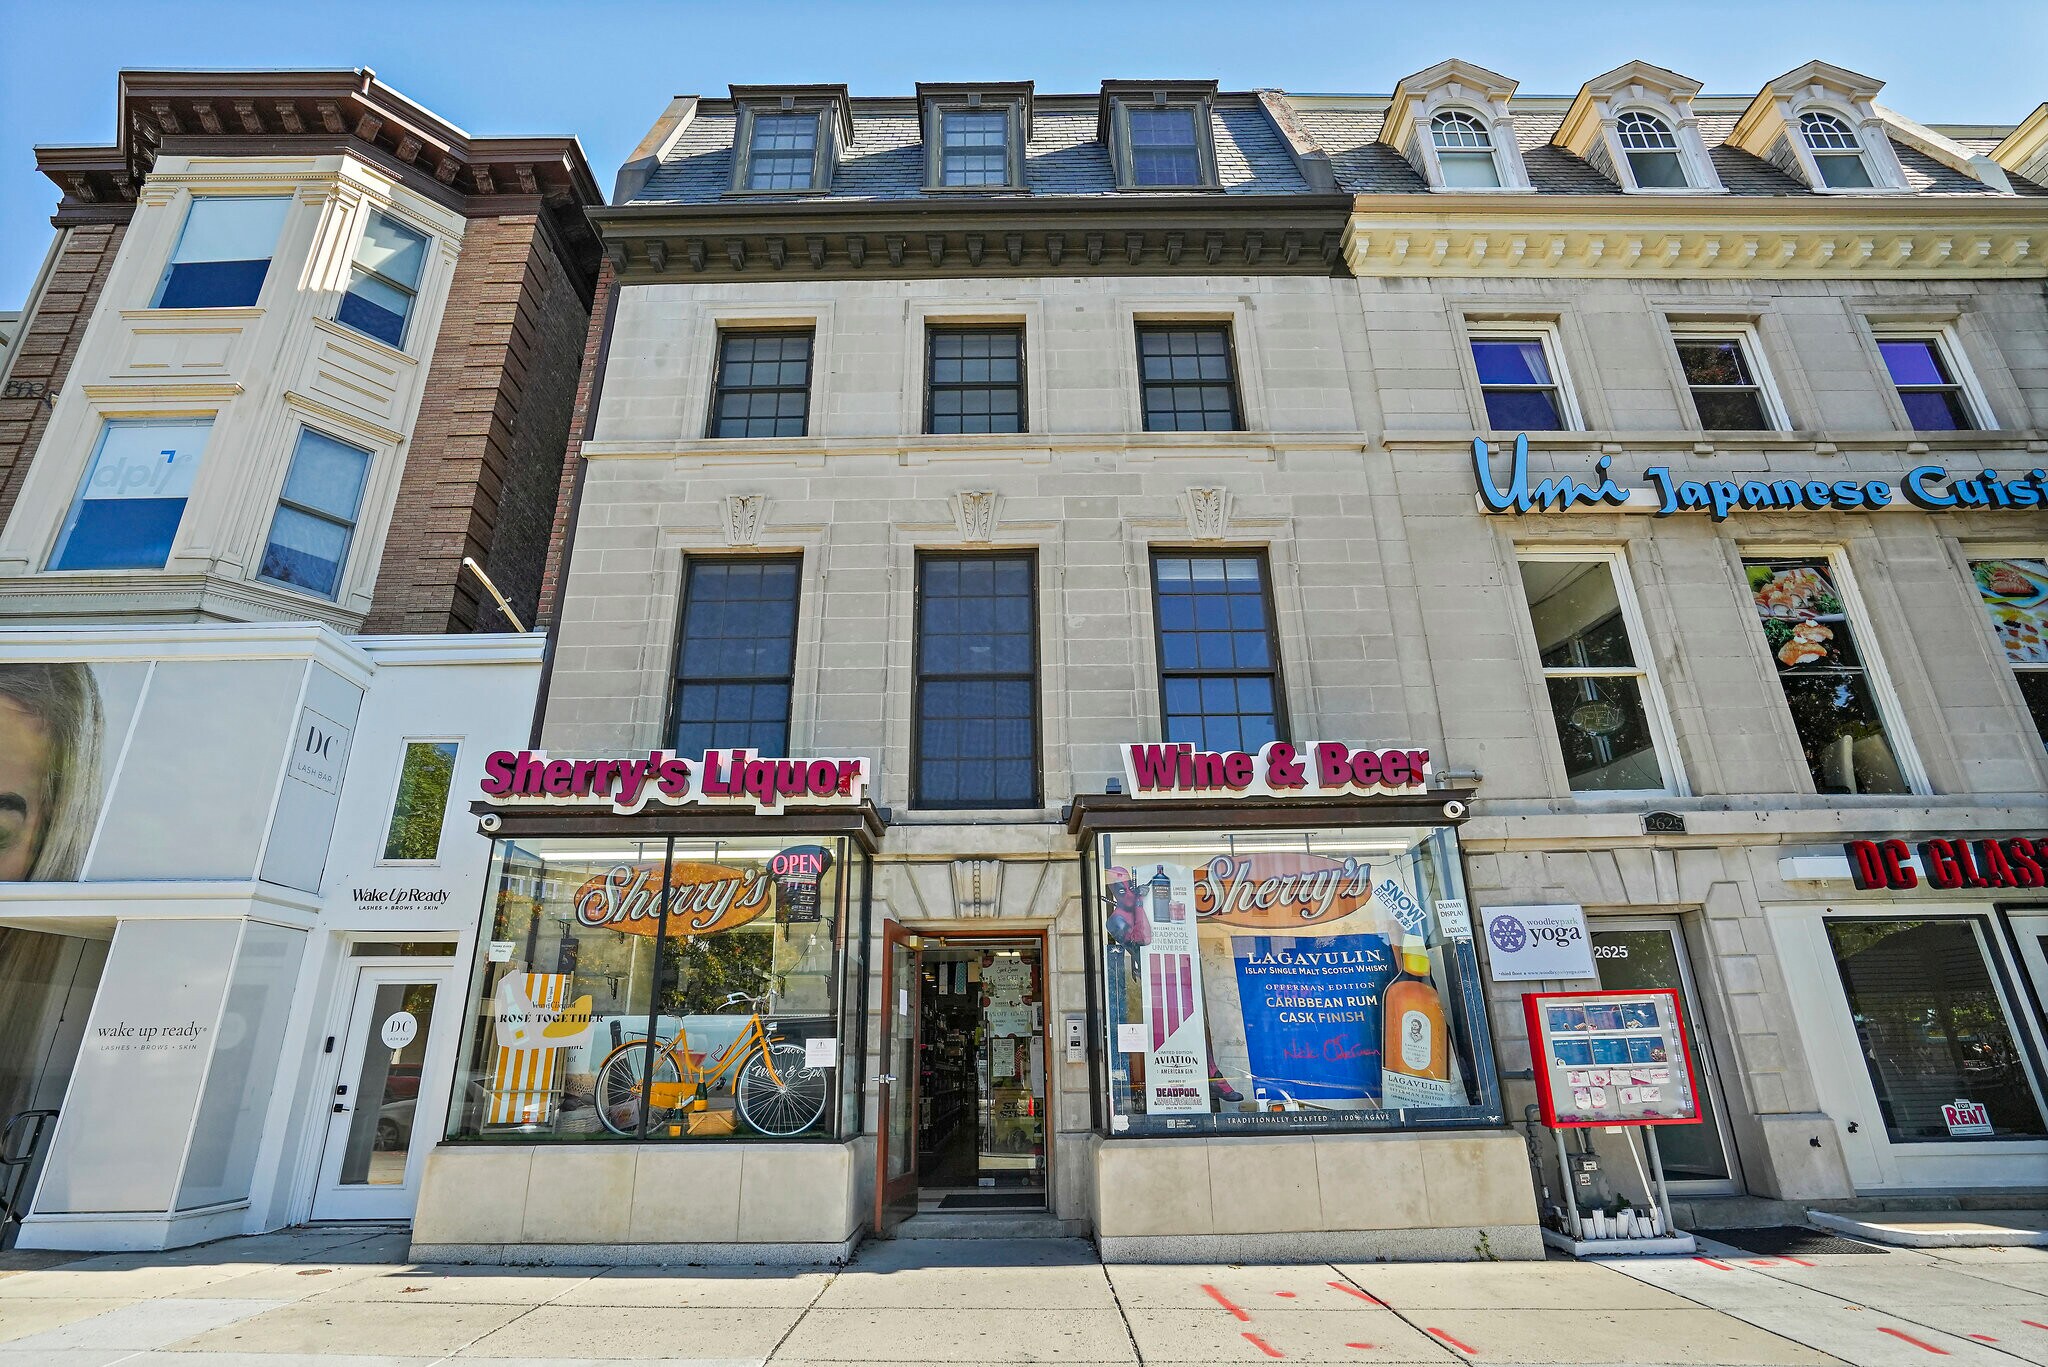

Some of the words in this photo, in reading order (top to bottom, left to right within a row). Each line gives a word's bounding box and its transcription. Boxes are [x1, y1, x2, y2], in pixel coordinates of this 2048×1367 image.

[1471, 432, 1630, 515] Umi
[1644, 467, 1892, 522] Japanese
[306, 726, 339, 761] DC
[297, 763, 316, 777] LASH
[318, 772, 333, 782] BAR
[1130, 744, 1254, 790] Wine
[1265, 742, 1309, 789] &
[1314, 742, 1429, 789] Beer
[480, 750, 691, 807] Sherry's
[700, 749, 862, 807] Liquor
[1647, 817, 1683, 830] 2625
[772, 853, 823, 875] OPEN
[1846, 839, 1918, 890] DC
[1921, 837, 2048, 890] GLAS
[1194, 855, 1371, 919] Sherry's
[353, 888, 388, 902] Wake
[389, 888, 408, 904] Up
[408, 888, 451, 905] Ready
[1374, 888, 1398, 913] BEER
[1381, 879, 1425, 922] SNOW
[1438, 901, 1462, 910] DUMMY
[1440, 910, 1464, 918] DISPLAY
[1444, 926, 1469, 934] LIQUOR
[1526, 918, 1579, 927] woodleypark
[1529, 926, 1582, 947] yoga
[1594, 945, 1629, 959] 2625
[1245, 966, 1267, 975] ISLAY
[1269, 966, 1297, 975] SINGLE
[1299, 967, 1320, 975] MALT
[1322, 966, 1354, 975] SCOTCH
[1355, 964, 1388, 973] WHISKY
[1328, 982, 1375, 991] EDITION
[1266, 997, 1343, 1008] CARIBBEAN
[1346, 995, 1378, 1007] RUM
[500, 1011, 532, 1022] ROSÉ
[536, 1014, 604, 1023] TOGETHER
[1279, 1012, 1315, 1023] CASK
[1318, 1011, 1365, 1023] FINISH
[98, 1021, 135, 1037] wake
[138, 1027, 158, 1041] up
[390, 1021, 411, 1032] DC
[1154, 1056, 1199, 1065] AVIATION
[1388, 1075, 1445, 1092] LAGAVULIN
[1156, 1087, 1200, 1098] DEADPOOL
[1227, 1116, 1289, 1124] TRADITIONALLY
[1364, 1113, 1390, 1121] AGAVE
[1945, 1106, 1987, 1126] RENT
